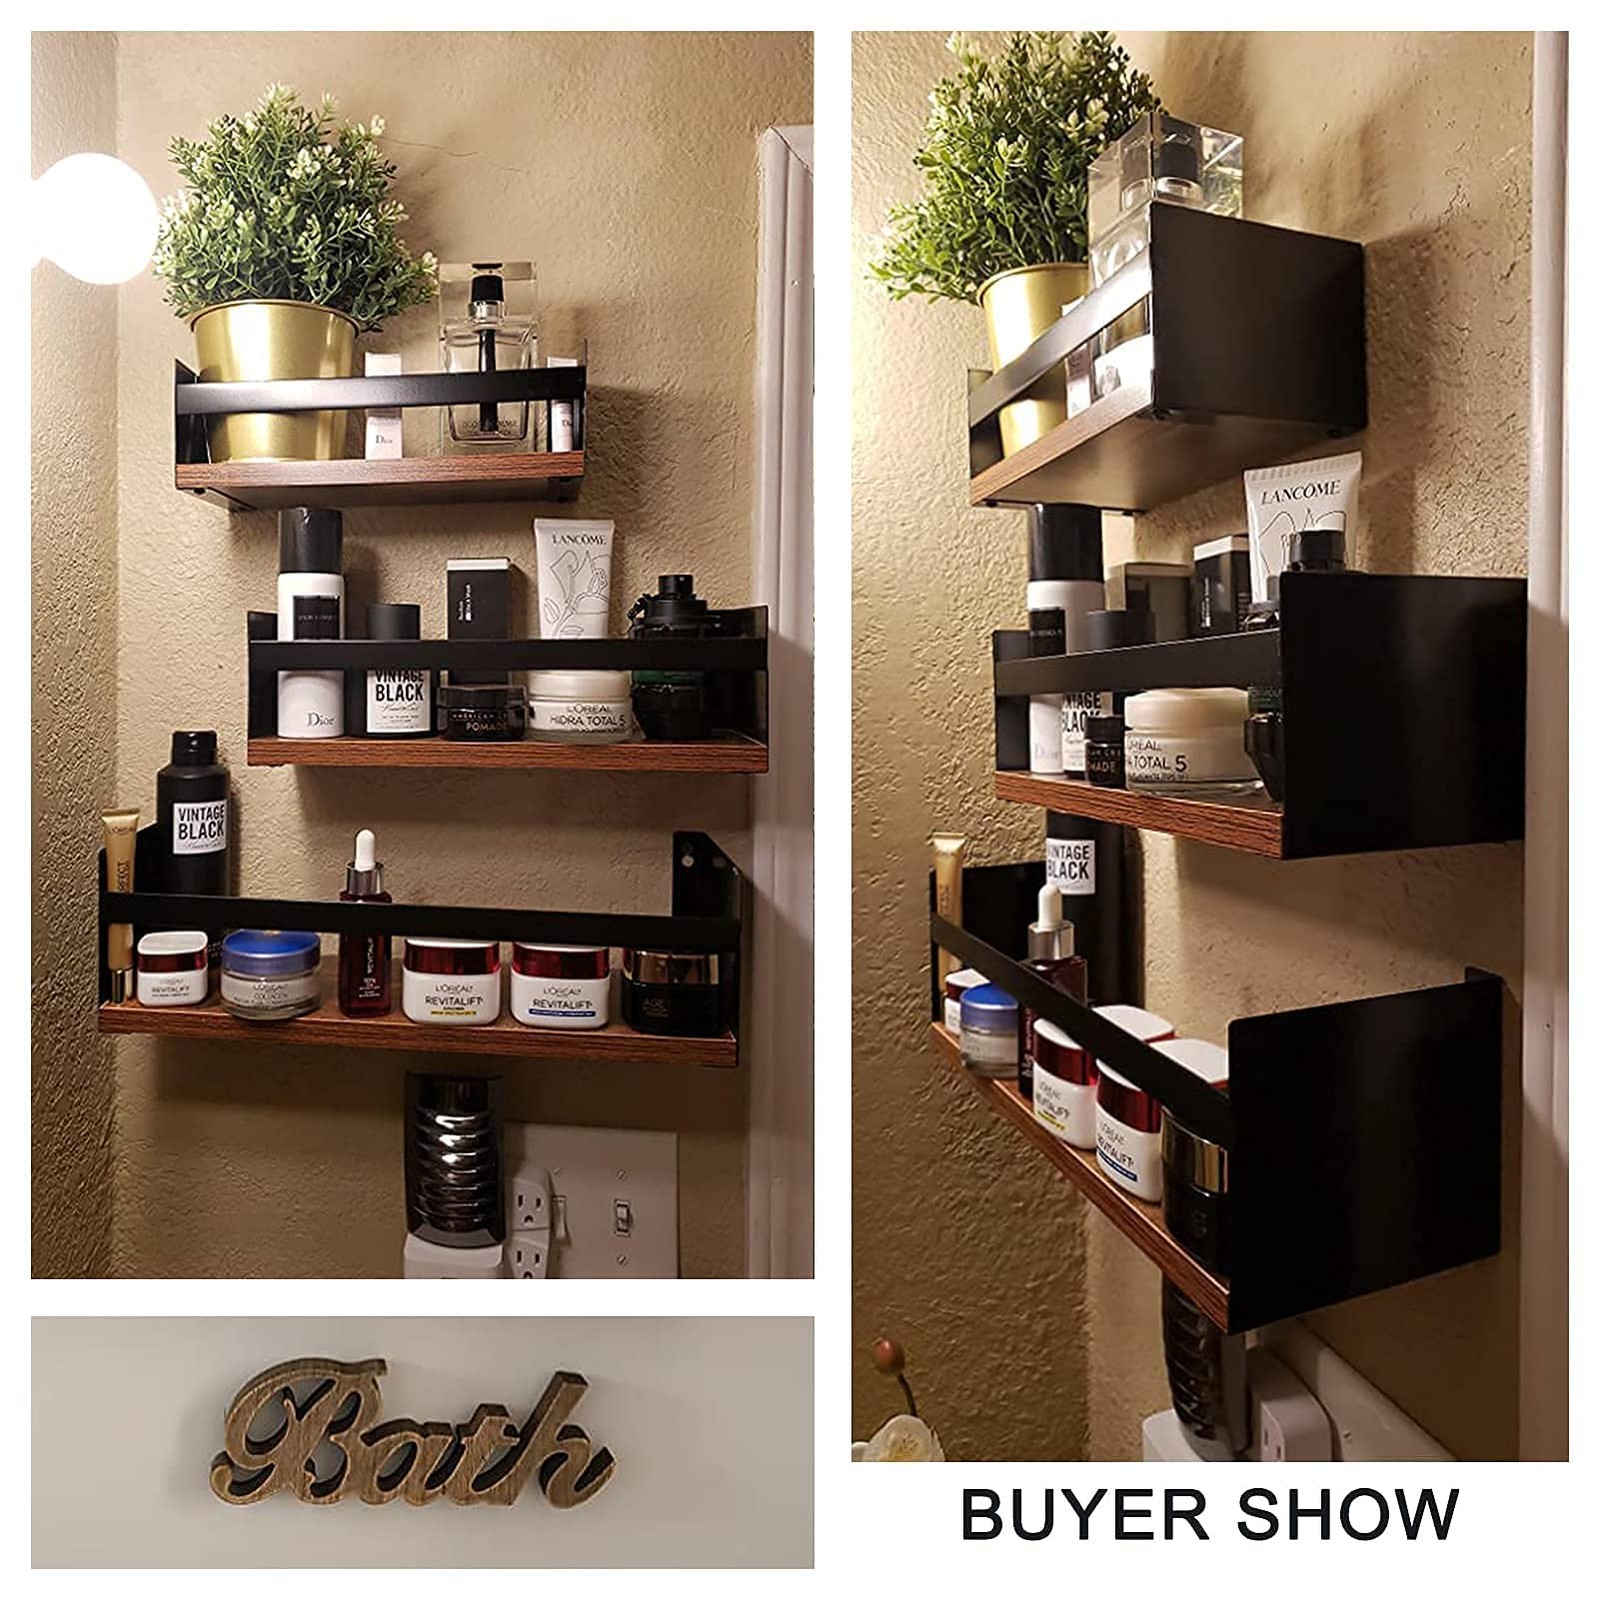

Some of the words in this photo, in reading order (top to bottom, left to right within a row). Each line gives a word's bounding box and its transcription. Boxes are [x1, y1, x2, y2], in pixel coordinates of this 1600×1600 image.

[375, 684, 424, 702] BLACK
[307, 711, 335, 727] Dior
[618, 714, 627, 727] 5
[1133, 754, 1171, 771] TOTAL
[1175, 754, 1188, 772] 5
[178, 804, 225, 822] VINTAGE
[178, 820, 225, 841] BLACK
[425, 996, 482, 1007] REVITALIFT
[532, 998, 592, 1010] REVITALIFT
[209, 1358, 616, 1510] Bath
